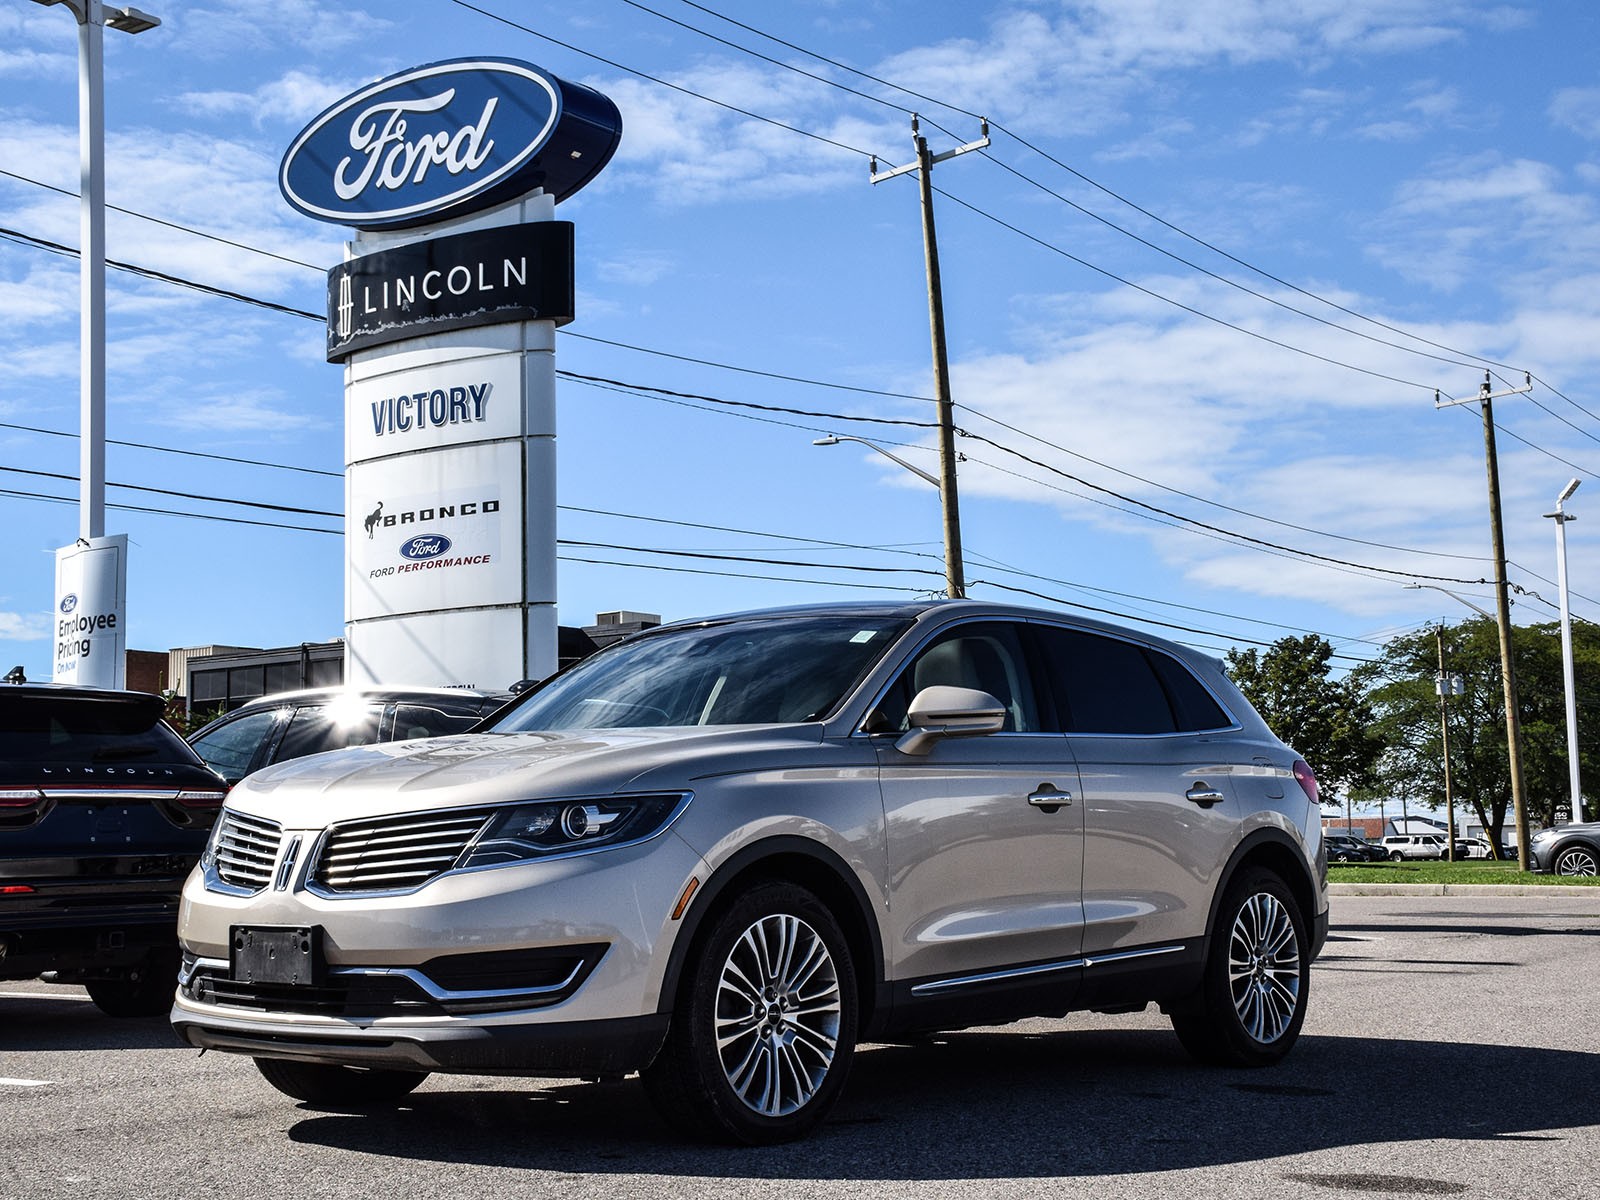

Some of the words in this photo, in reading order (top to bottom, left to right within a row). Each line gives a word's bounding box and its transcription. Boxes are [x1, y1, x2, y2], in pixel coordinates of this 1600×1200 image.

[334, 88, 498, 200] Ford
[364, 257, 527, 314] LINCOLN
[371, 383, 493, 436] VICTORY
[383, 500, 499, 527] BRONCO
[409, 538, 441, 556] Ford
[370, 566, 394, 578] FORD
[397, 554, 491, 574] PERFORMANCE
[59, 613, 116, 639] Employee
[58, 638, 91, 660] Pricing
[43, 767, 173, 775] LINCOLN
